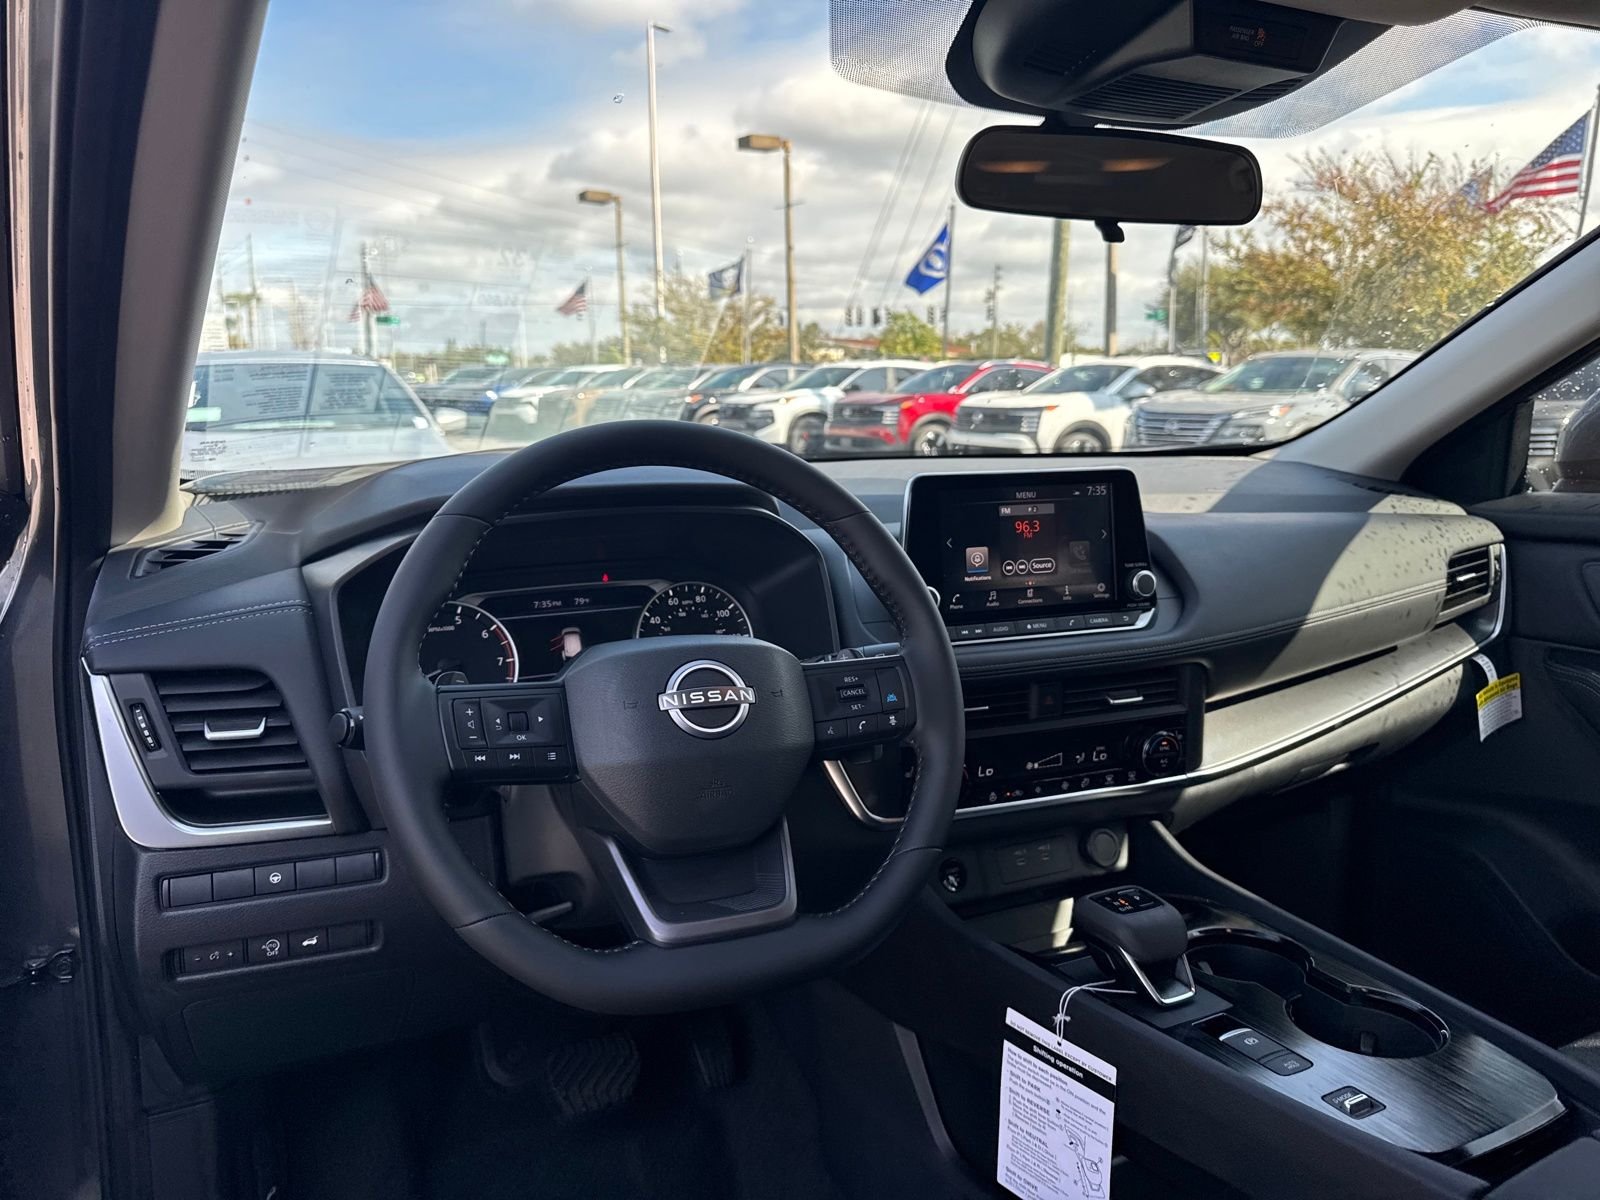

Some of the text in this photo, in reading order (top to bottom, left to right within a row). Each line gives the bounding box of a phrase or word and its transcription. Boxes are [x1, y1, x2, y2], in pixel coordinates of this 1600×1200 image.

[1015, 491, 1037, 499] MENU
[1086, 485, 1107, 496] 7:35
[1015, 520, 1040, 533] 96.3
[1032, 561, 1052, 569] Source
[668, 597, 679, 605] 60
[695, 594, 706, 603] 80
[716, 609, 730, 618] 100
[455, 615, 462, 624] 5
[650, 616, 661, 624] 40
[481, 629, 489, 638] 6
[497, 657, 503, 666] 7
[842, 688, 865, 697] CANCEL
[662, 689, 753, 707] NISSAN
[1092, 750, 1108, 762] Lo
[978, 766, 994, 777] Lo
[1033, 1044, 1084, 1079] Shifting operation
[1064, 1051, 1081, 1063] EXCEPT
[1088, 1064, 1112, 1081] CUSTOMER
[1038, 1065, 1050, 1075] each
[1010, 1070, 1021, 1082] Shift
[1027, 1080, 1041, 1093] PARK
[1026, 1097, 1050, 1117] REVERSE
[1025, 1129, 1049, 1149] NEUTRAL
